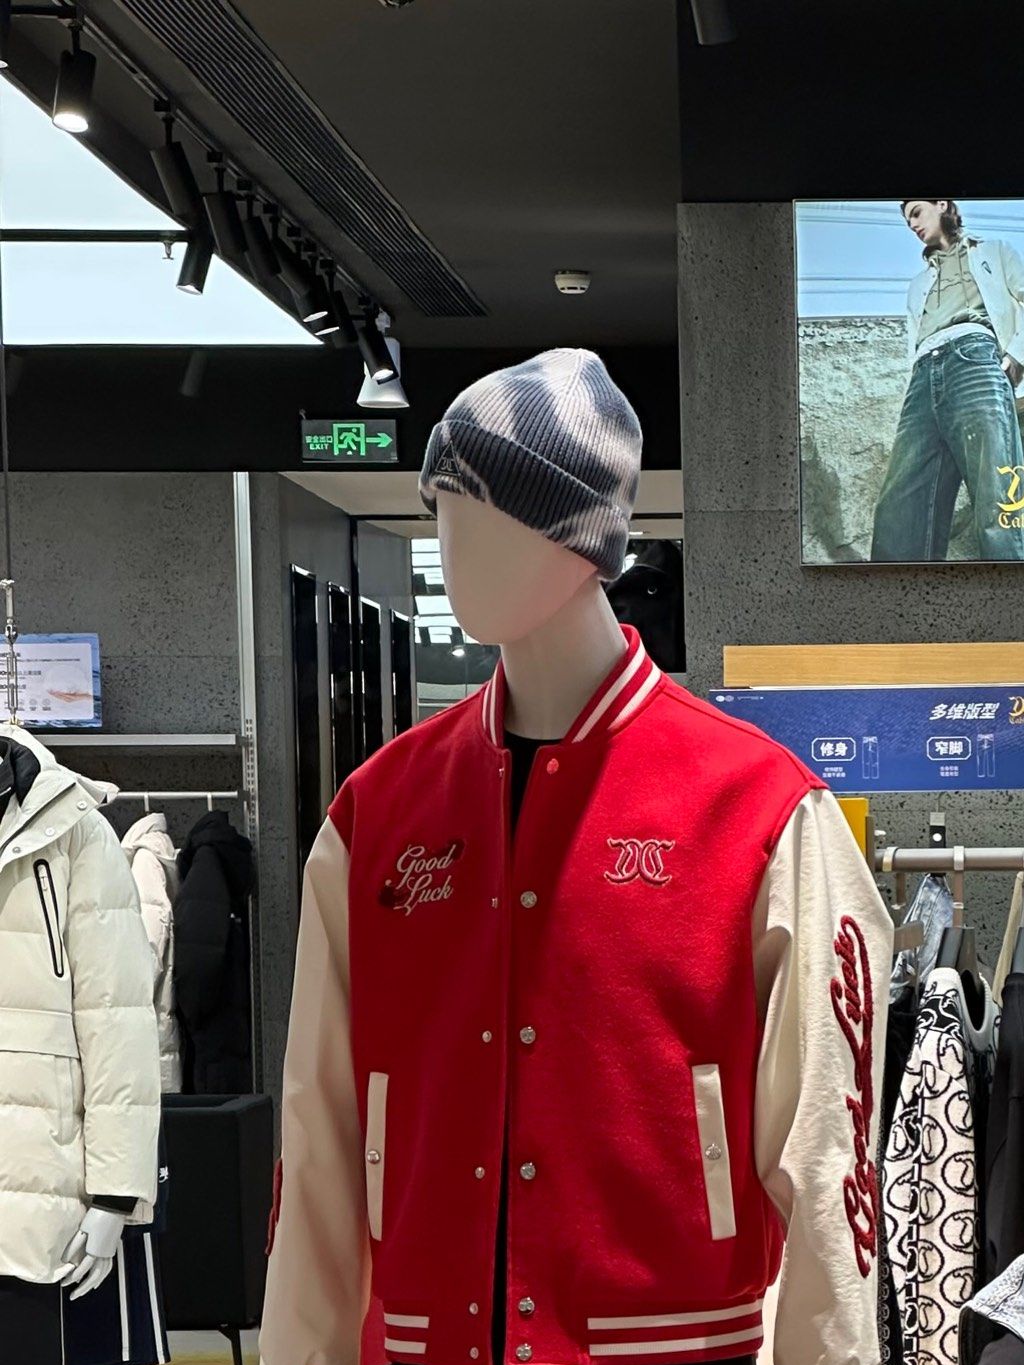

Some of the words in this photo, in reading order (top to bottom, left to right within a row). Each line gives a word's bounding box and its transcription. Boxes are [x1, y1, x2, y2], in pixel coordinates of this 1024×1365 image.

[929, 703, 1000, 720] 多维版型
[820, 742, 848, 757] 修身
[935, 741, 963, 755] 窄脚
[396, 844, 456, 889] Good
[394, 874, 454, 916] Luck
